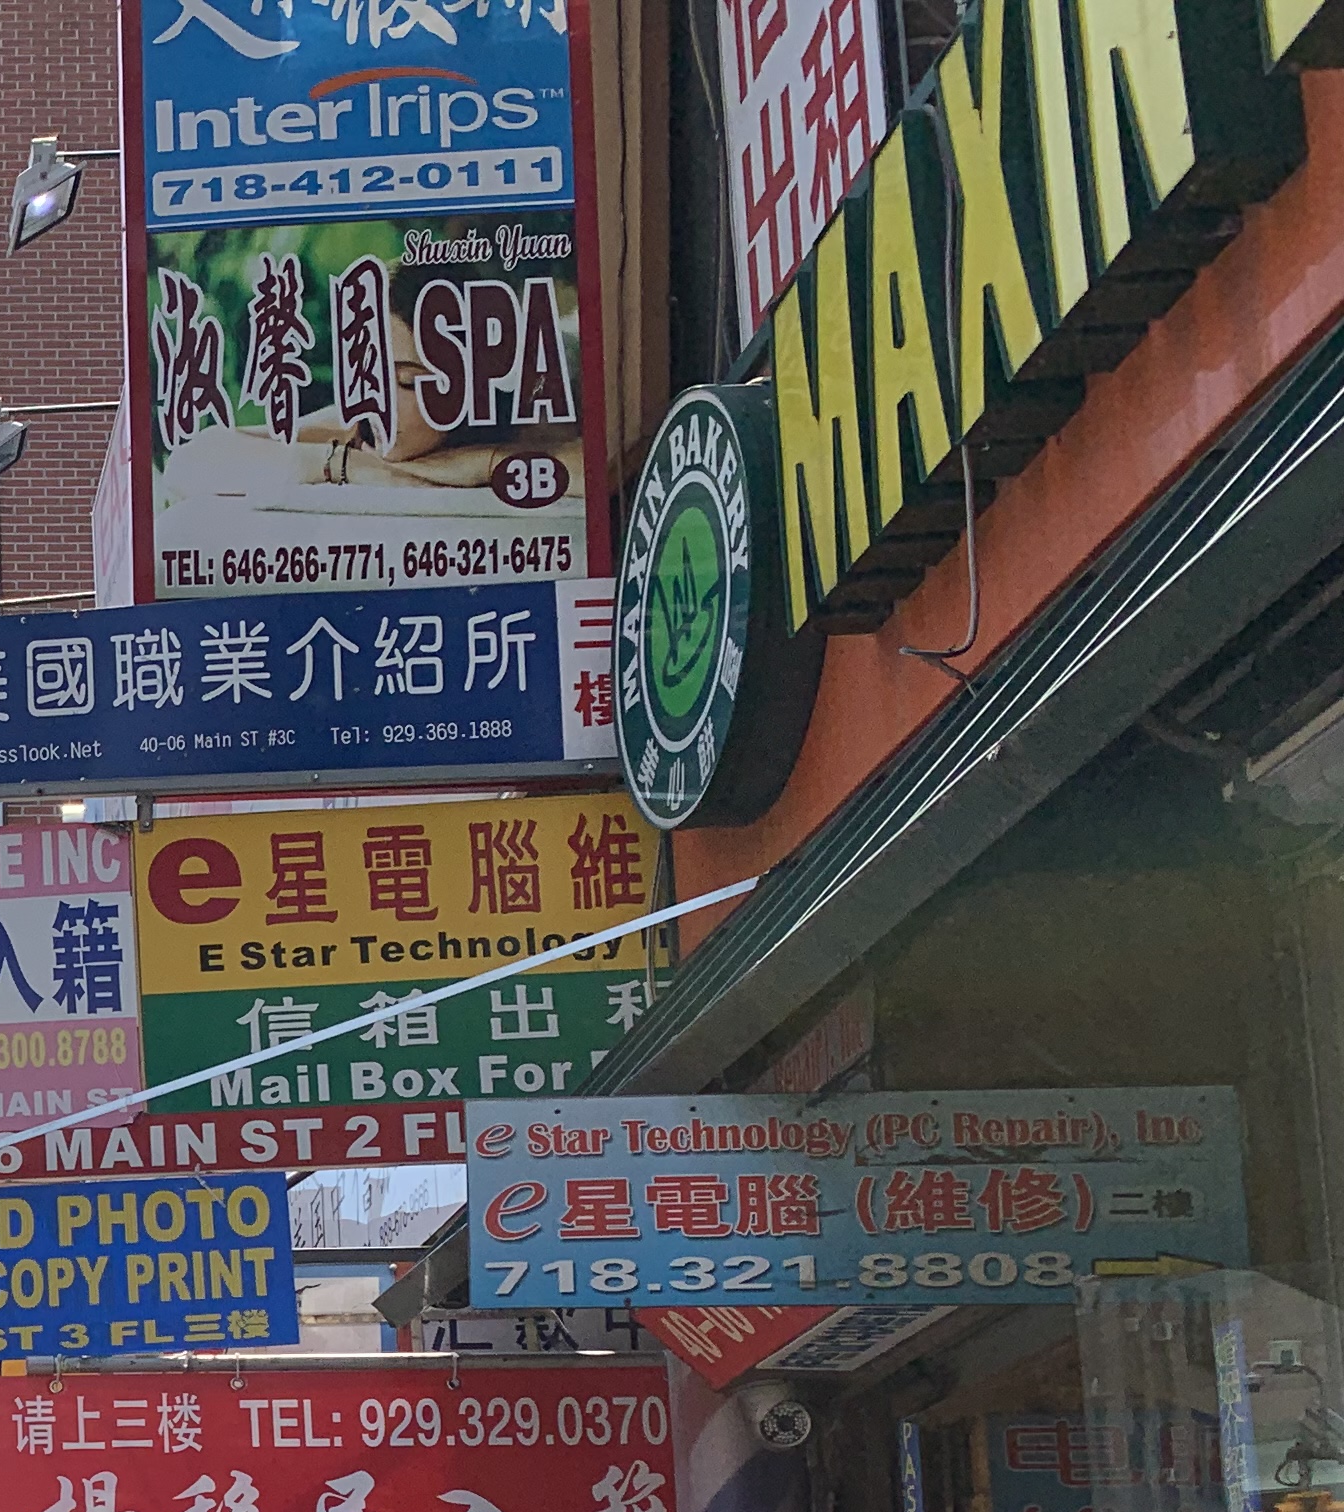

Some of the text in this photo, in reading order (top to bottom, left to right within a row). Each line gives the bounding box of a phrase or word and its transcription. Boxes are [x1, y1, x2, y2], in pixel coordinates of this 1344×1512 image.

[155, 97, 351, 153] Inter
[162, 156, 555, 206] 718-412-0111
[403, 224, 571, 272] Shuxin Yuan
[414, 277, 576, 430] SPA
[505, 457, 558, 500] 3B
[668, 413, 750, 575] BAKERY
[162, 549, 215, 587] TEL:
[403, 536, 572, 578] 646-321-6475
[139, 729, 296, 754] 40-06 Main ST #3C
[330, 719, 513, 746] Tel: 929.369.1888
[41, 828, 122, 886] INC
[199, 943, 225, 972] E
[241, 939, 337, 971] Star
[211, 1055, 573, 1107] Mail Box For
[45, 1118, 217, 1173] MAIN
[239, 1116, 323, 1163] ST
[345, 1114, 382, 1158] 2
[527, 1120, 611, 1156] Star
[621, 1112, 855, 1158] Technology
[866, 1112, 940, 1151] (PC
[1136, 1109, 1201, 1146] Inc
[58, 1186, 271, 1248] PHOTO
[128, 1247, 274, 1302] PRINT
[484, 1252, 1074, 1297] 718.321.8808
[60, 1323, 89, 1348] 3
[111, 1319, 173, 1345] FL
[11, 1391, 670, 1455] 请上三楼 TEL: 929.329.0370
